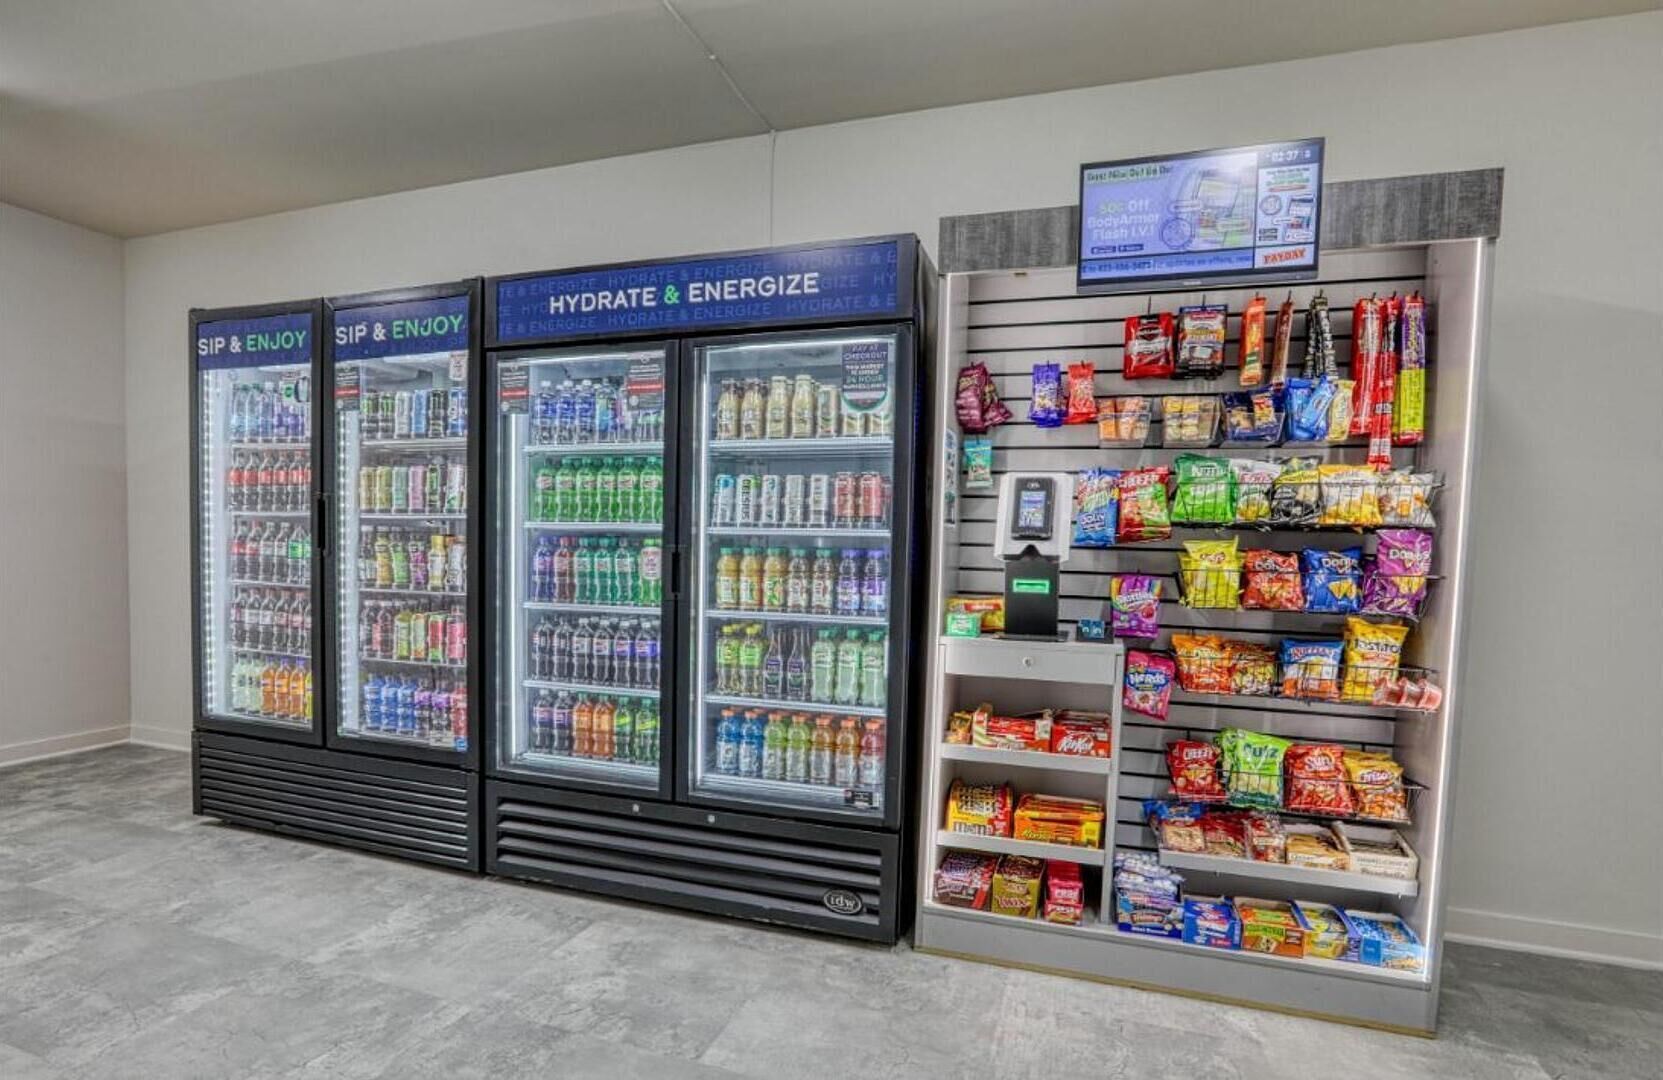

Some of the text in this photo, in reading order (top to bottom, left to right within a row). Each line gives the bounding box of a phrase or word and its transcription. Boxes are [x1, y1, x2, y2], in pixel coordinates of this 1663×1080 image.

[550, 272, 820, 315] HYDRATE & ENERGIZE
[198, 330, 307, 356] SIP & ENJOY
[335, 315, 464, 345] SIP & ENJOY
[843, 351, 887, 361] CHECKOUT
